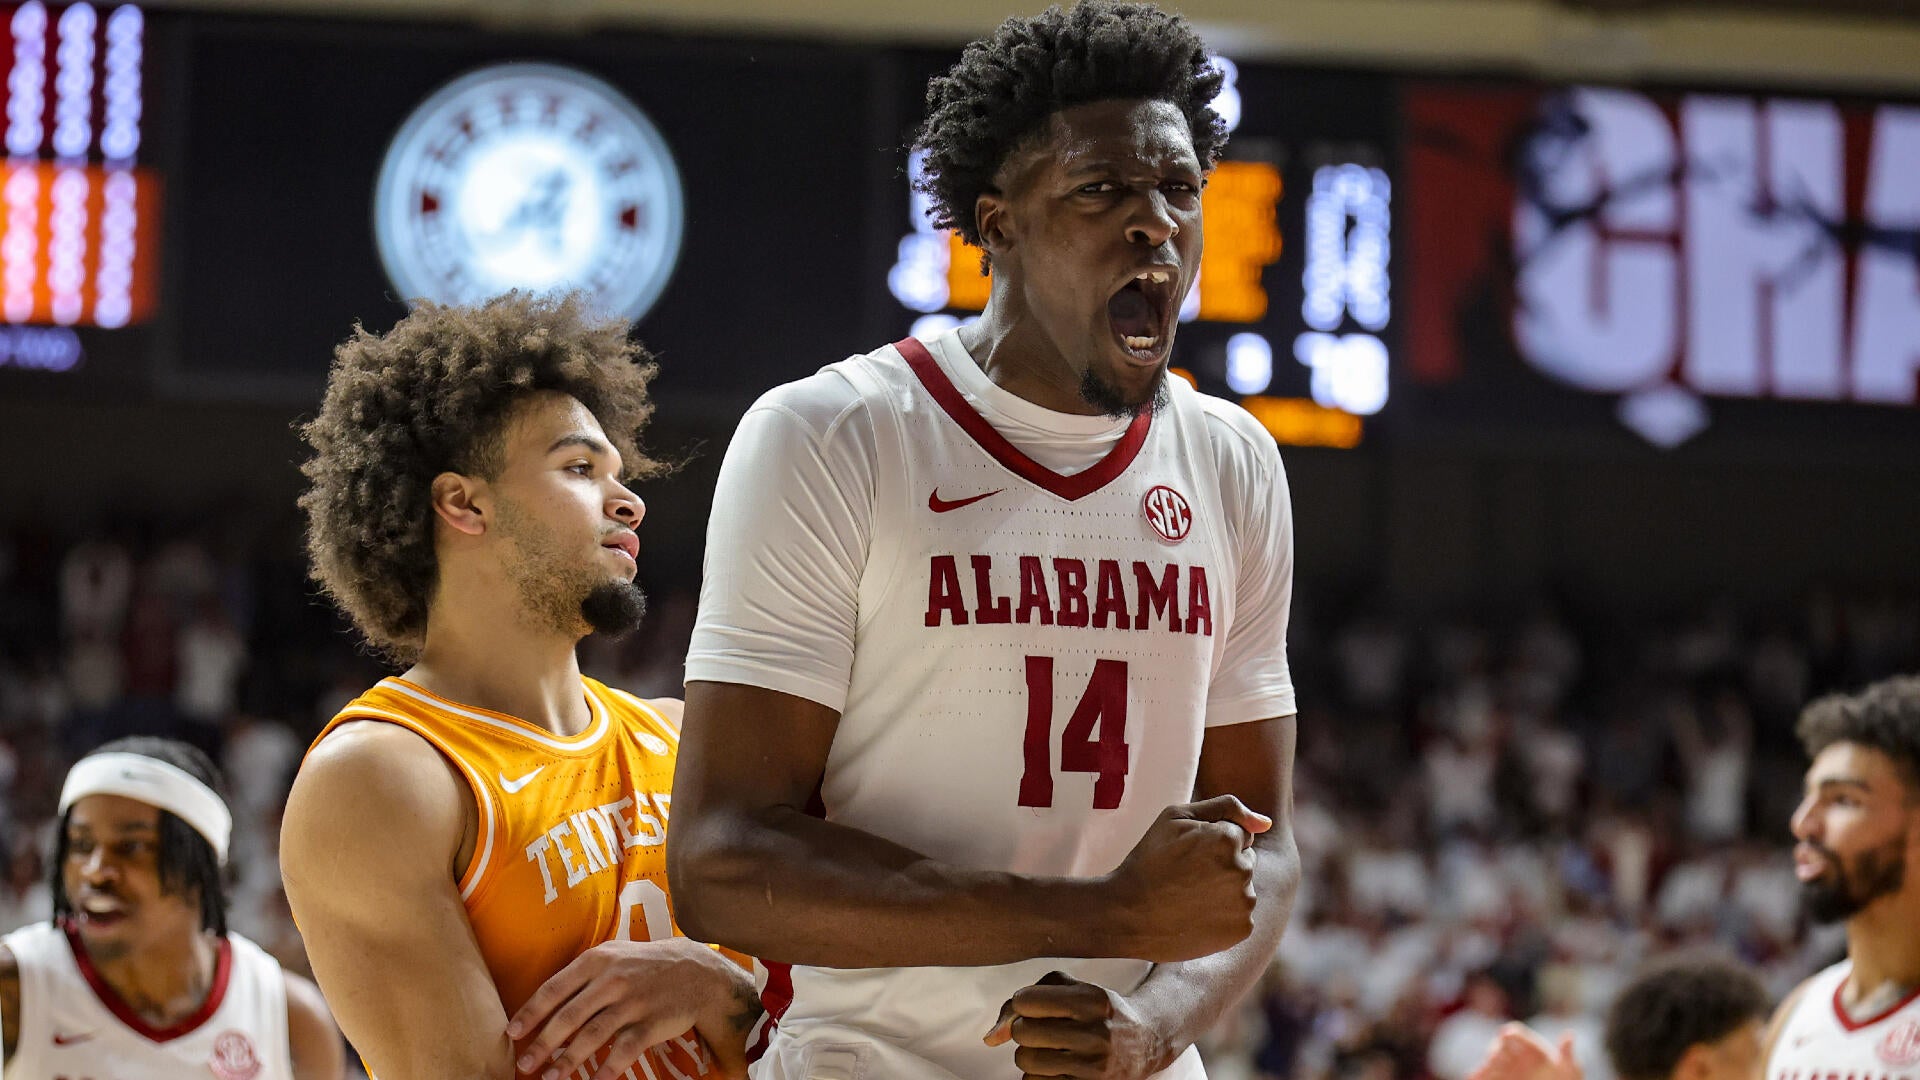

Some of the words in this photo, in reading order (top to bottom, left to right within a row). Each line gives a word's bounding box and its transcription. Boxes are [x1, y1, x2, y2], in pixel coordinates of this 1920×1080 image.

[1147, 488, 1190, 538] SEC
[924, 555, 1213, 636] ALABAMA
[1017, 655, 1129, 809] 14
